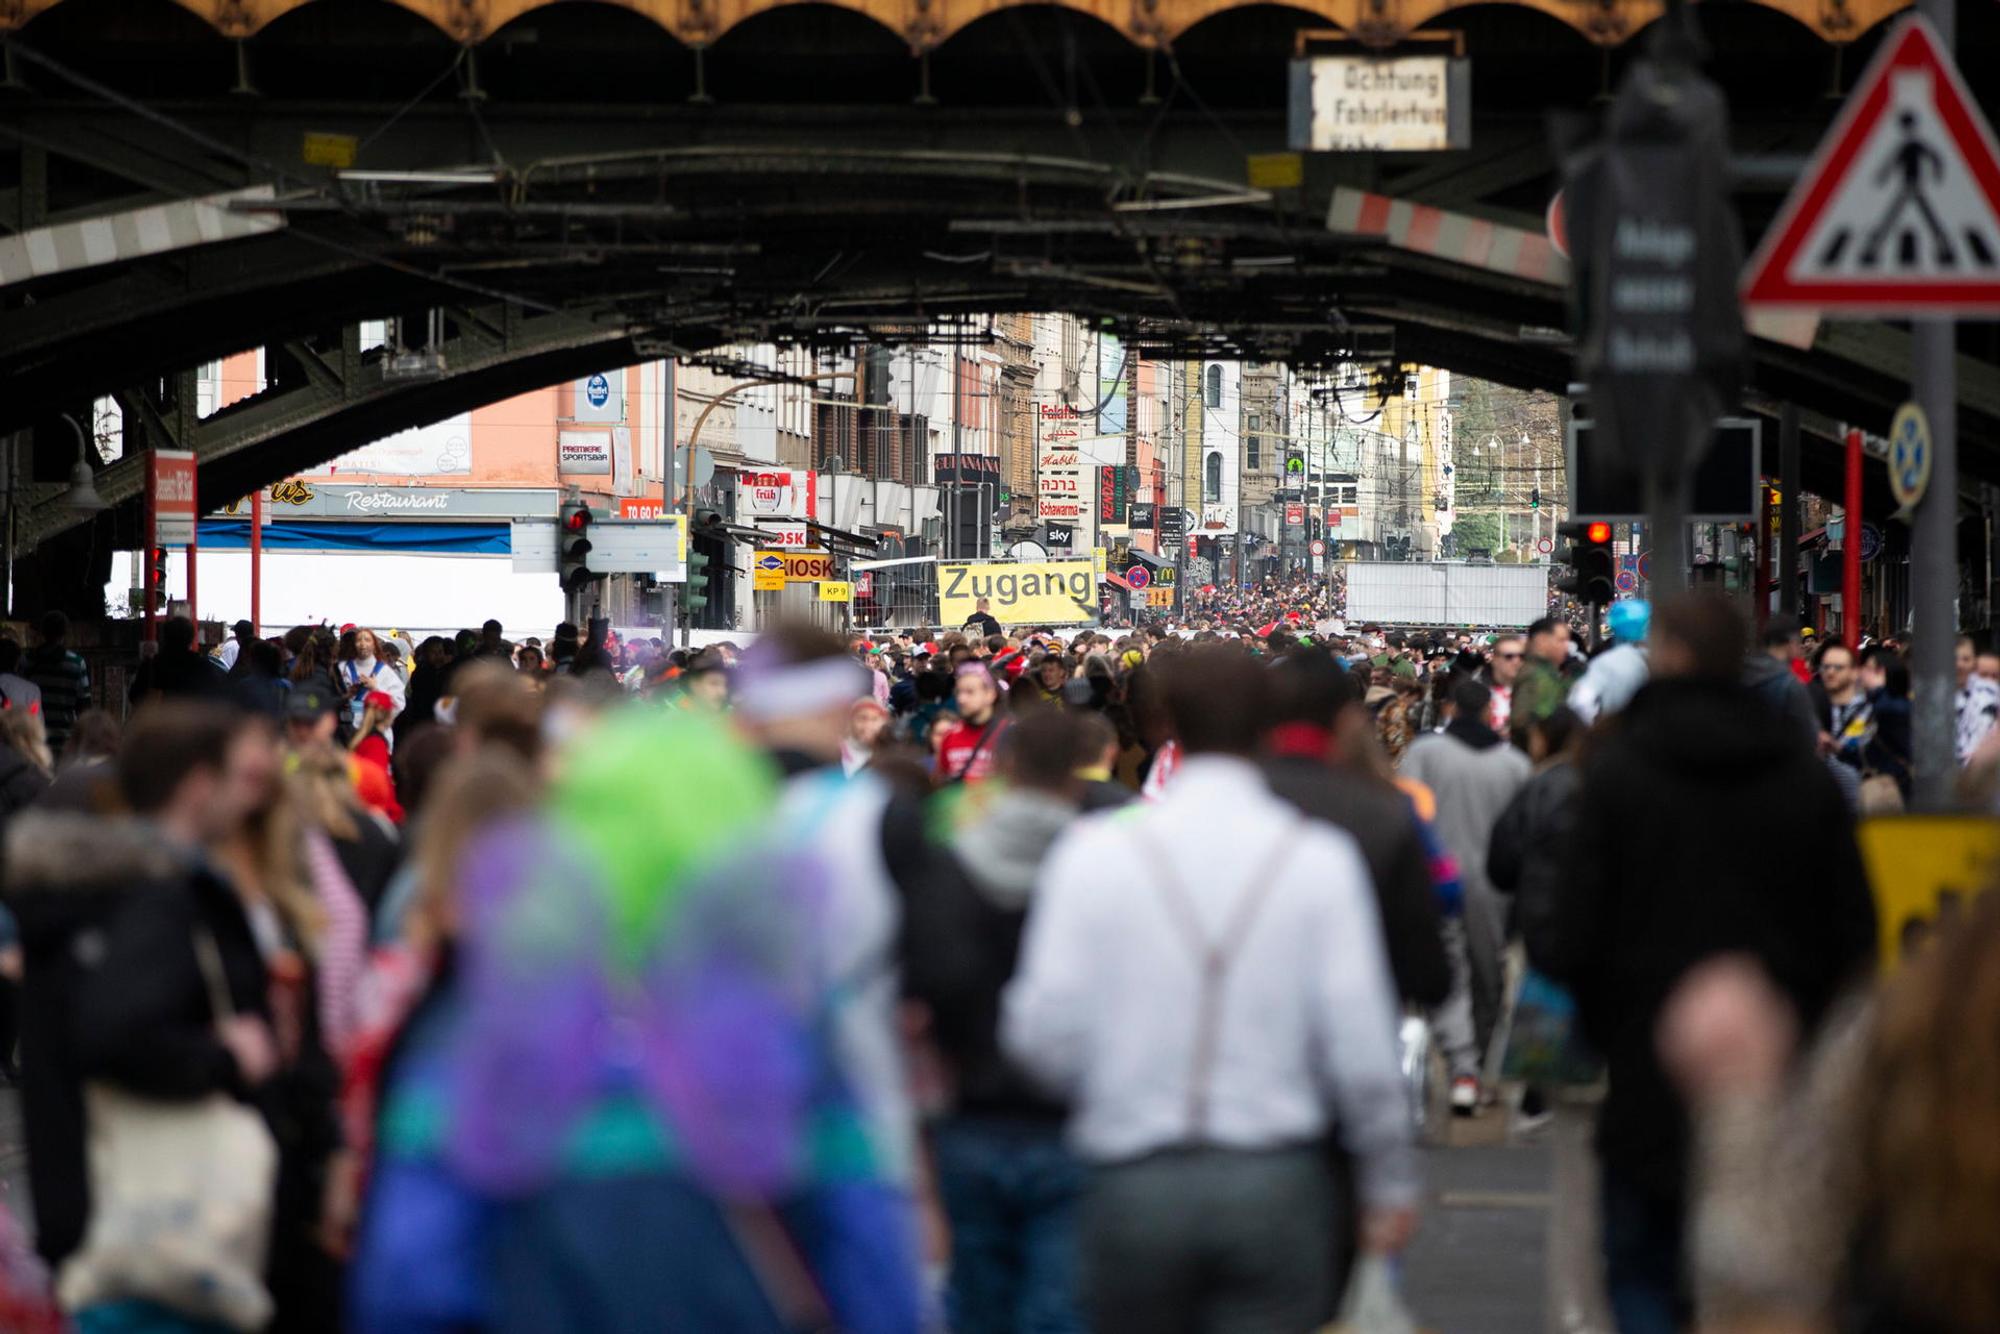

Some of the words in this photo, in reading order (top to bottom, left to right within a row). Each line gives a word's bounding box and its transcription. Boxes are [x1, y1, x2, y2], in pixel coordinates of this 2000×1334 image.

[1041, 404, 1078, 420] Falafel
[562, 445, 602, 453] PREMIERE
[1041, 479, 1077, 491] ברכה
[345, 489, 450, 511] Restaurant
[756, 488, 776, 500] früh
[627, 506, 638, 519] TO
[639, 506, 651, 519] GO
[1039, 501, 1078, 517] Schawarma
[1049, 530, 1070, 543] sky
[827, 587, 839, 595] KP
[840, 587, 846, 595] 9
[945, 567, 1091, 606] Zugang
